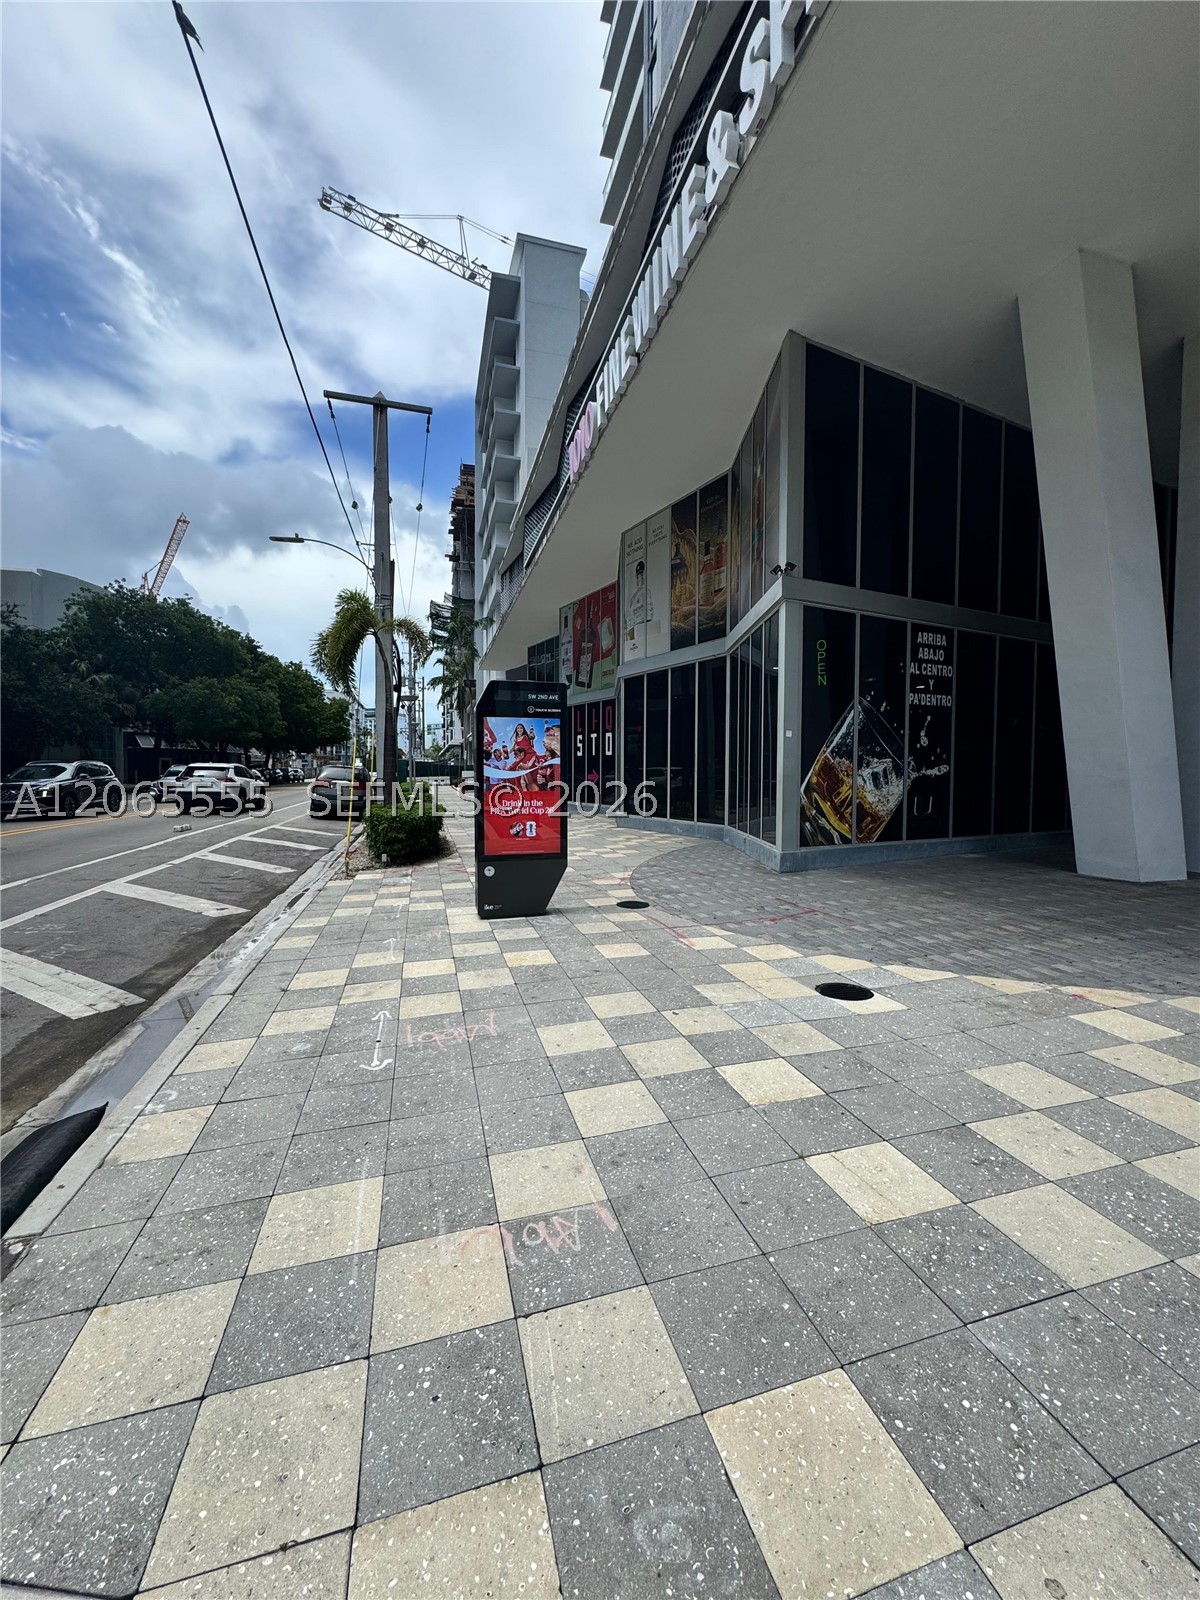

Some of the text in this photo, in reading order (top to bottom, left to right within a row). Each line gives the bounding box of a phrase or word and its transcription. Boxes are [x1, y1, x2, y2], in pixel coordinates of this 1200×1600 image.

[596, 318, 638, 428] FINE
[632, 163, 707, 353] WINE
[705, 110, 740, 206] &
[916, 631, 947, 647] ARRIBA
[816, 639, 827, 686] OPEN
[917, 647, 945, 662] ABAJO
[909, 661, 953, 678] AL CENTRO
[928, 678, 934, 691] Y
[576, 732, 613, 757] STO
[531, 799, 543, 807] the
[530, 807, 545, 816] Cup
